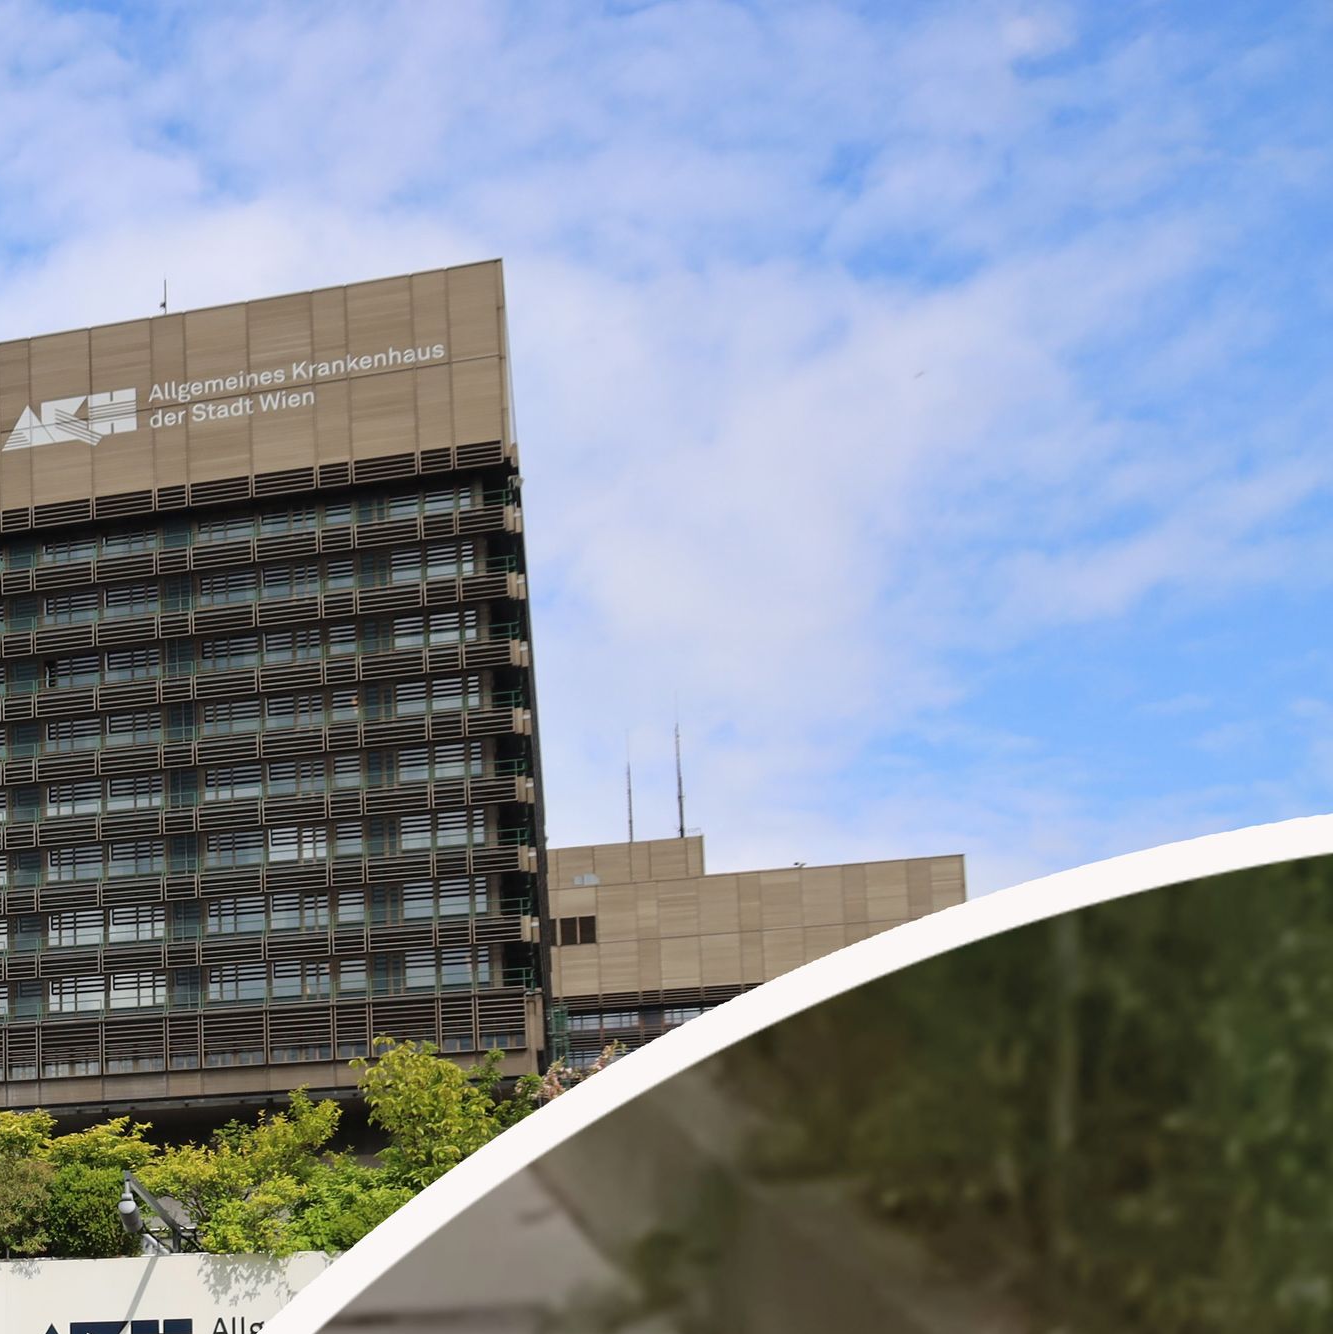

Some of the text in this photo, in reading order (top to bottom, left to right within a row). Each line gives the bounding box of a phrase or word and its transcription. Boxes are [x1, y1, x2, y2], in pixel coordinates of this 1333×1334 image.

[148, 343, 445, 403] Allgemeines Krankenhaus
[149, 389, 315, 428] der Stadt Wien
